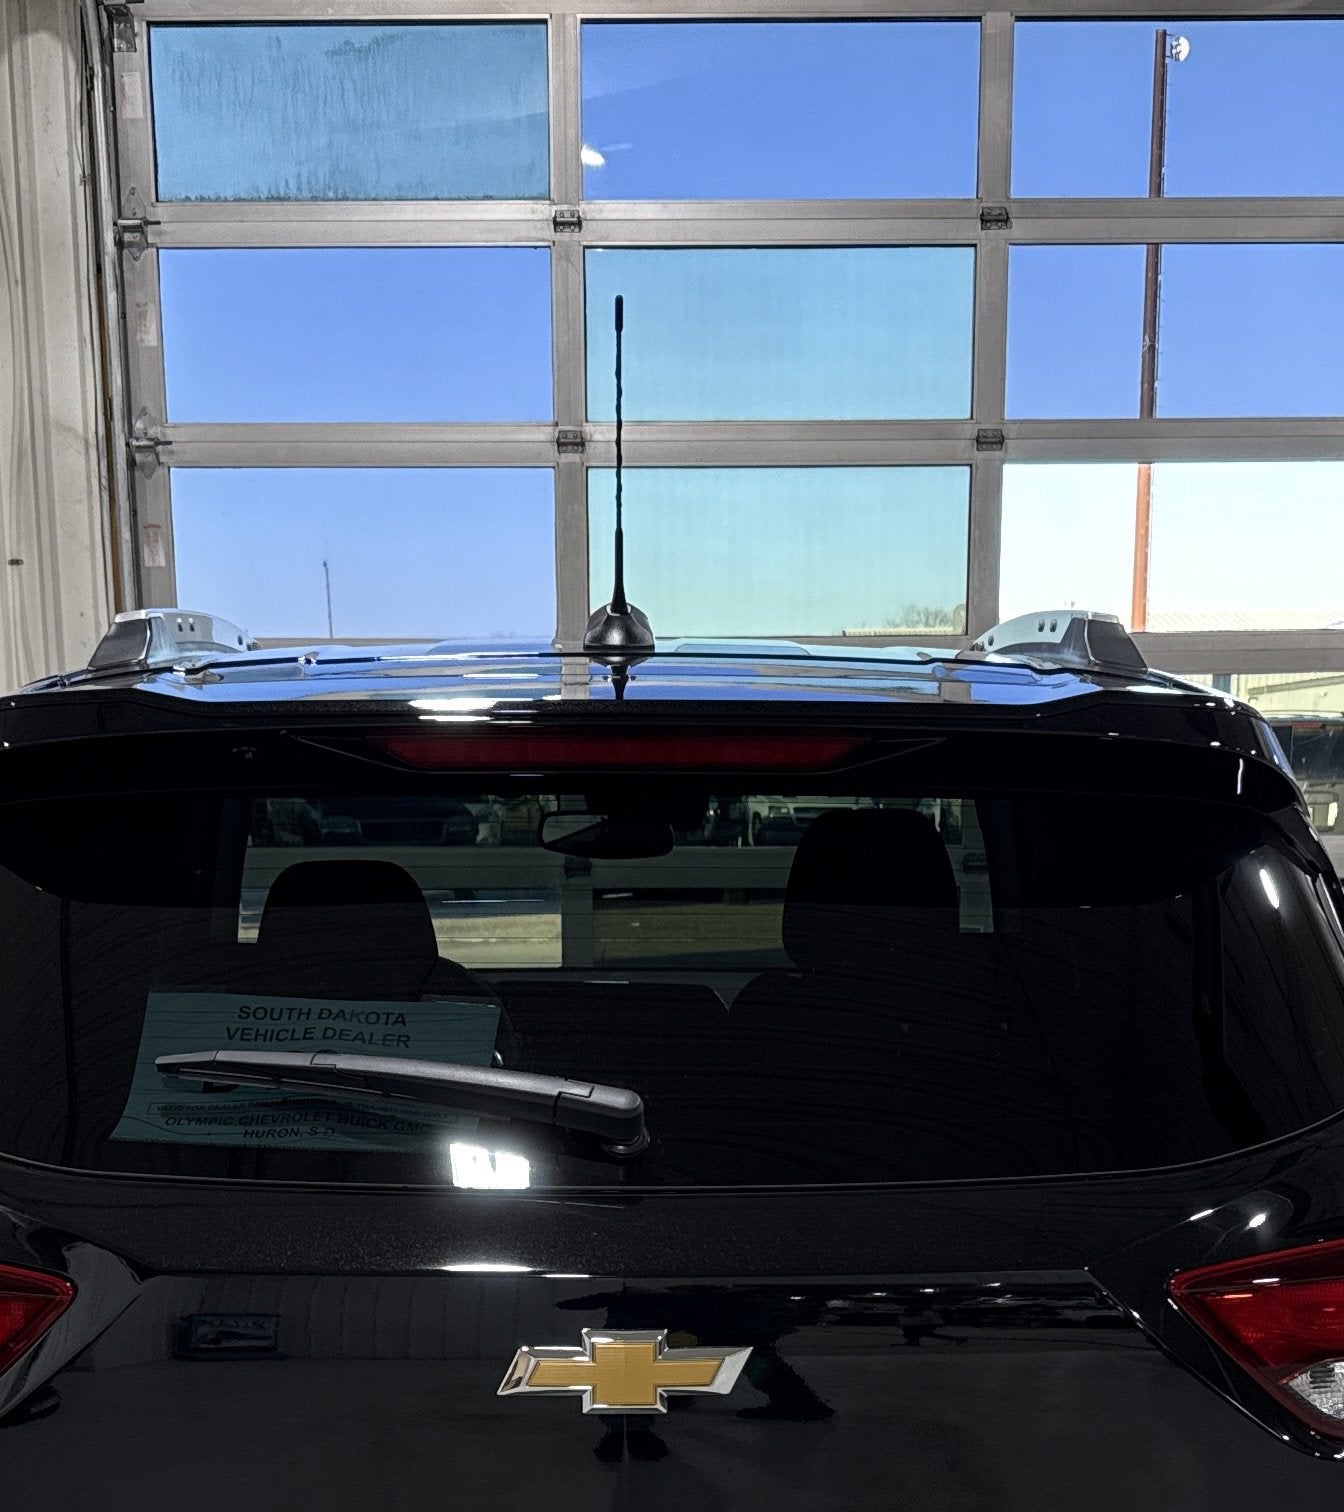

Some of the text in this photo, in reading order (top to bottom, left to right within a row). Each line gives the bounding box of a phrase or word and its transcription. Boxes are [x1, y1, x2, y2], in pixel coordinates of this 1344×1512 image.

[238, 1005, 406, 1027] SOUTH DAKOTA
[225, 1026, 411, 1049] VEHICLE DEALER
[165, 1117, 233, 1127] OLYMPIC
[238, 1113, 330, 1126] CHEVROLET
[338, 1114, 389, 1131] BUICK
